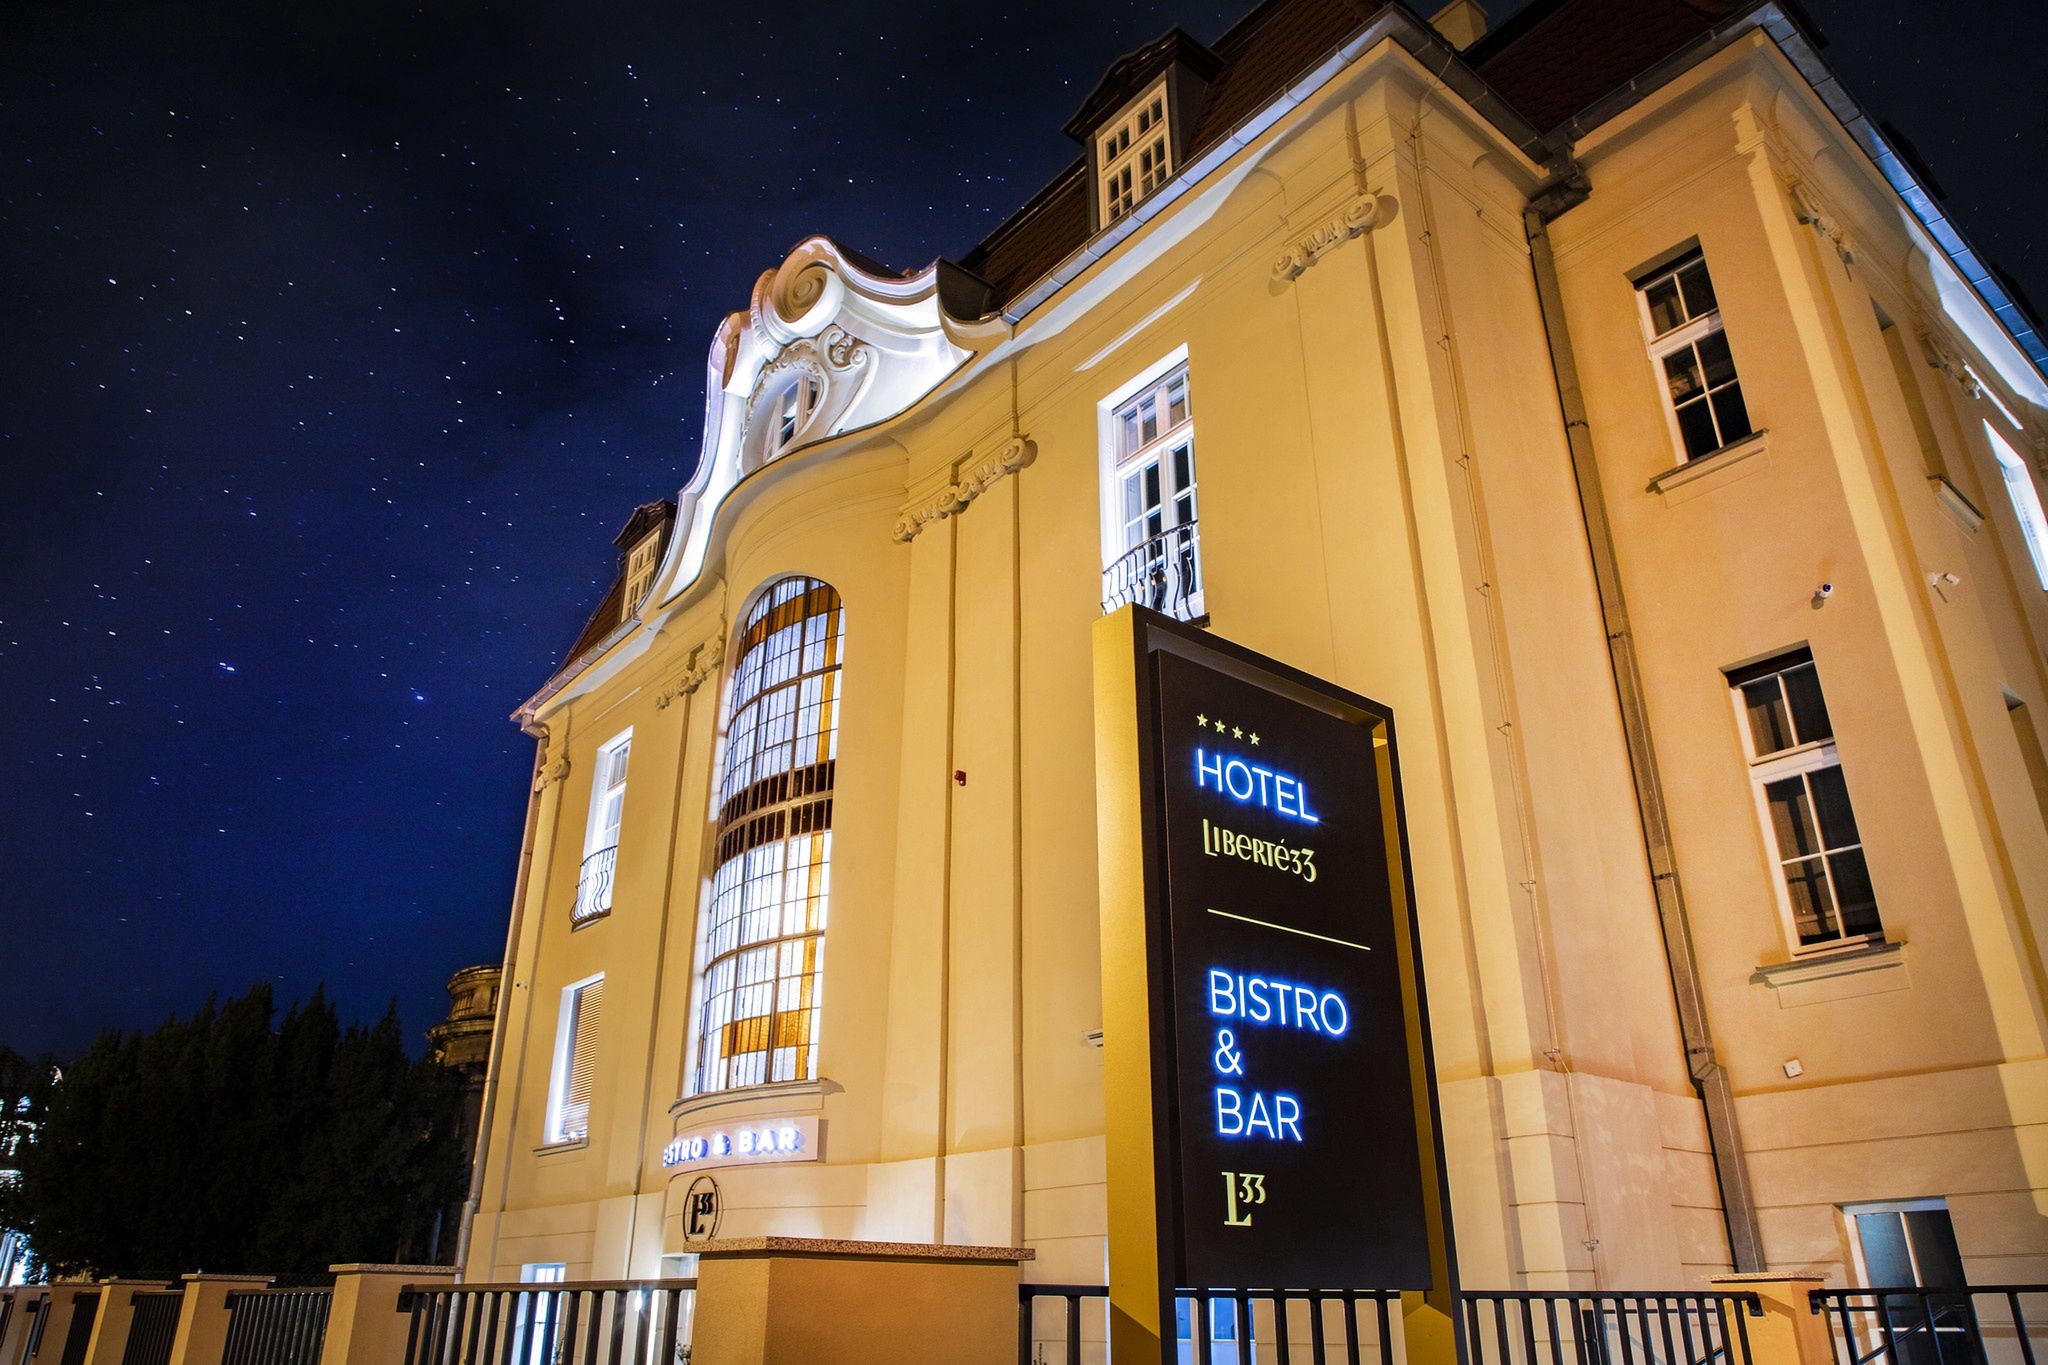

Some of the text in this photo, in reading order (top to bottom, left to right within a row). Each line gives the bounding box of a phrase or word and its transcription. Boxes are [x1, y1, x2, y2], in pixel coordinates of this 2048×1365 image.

[1197, 748, 1319, 822] HOTEL
[1210, 970, 1347, 1035] BISTRO
[1215, 1029, 1243, 1075] &
[713, 1132, 731, 1156] &
[738, 1126, 800, 1154] BAR
[1217, 1088, 1302, 1141] BAR
